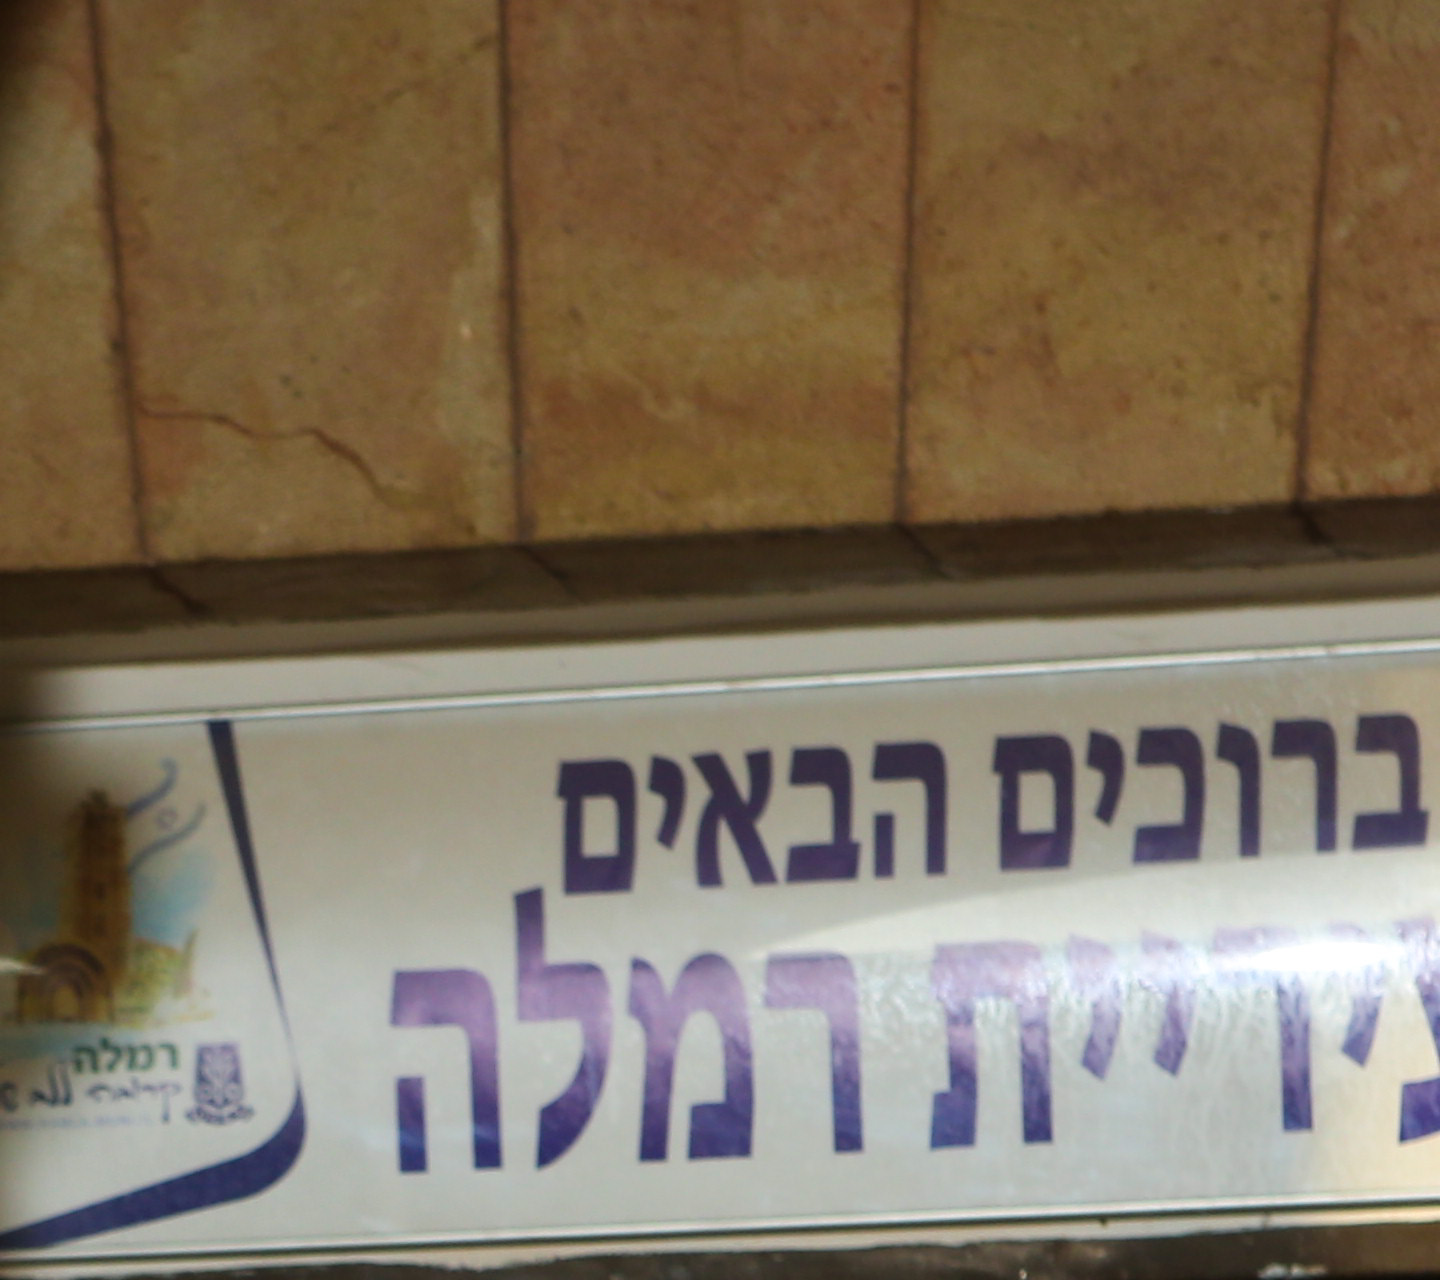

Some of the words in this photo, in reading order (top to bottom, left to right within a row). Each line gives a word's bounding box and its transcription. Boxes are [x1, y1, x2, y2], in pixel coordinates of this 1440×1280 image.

[557, 740, 947, 895] הבאים
[993, 713, 1429, 871] ברוכים
[73, 1037, 180, 1073] רמלה
[391, 887, 864, 1174] רמלה
